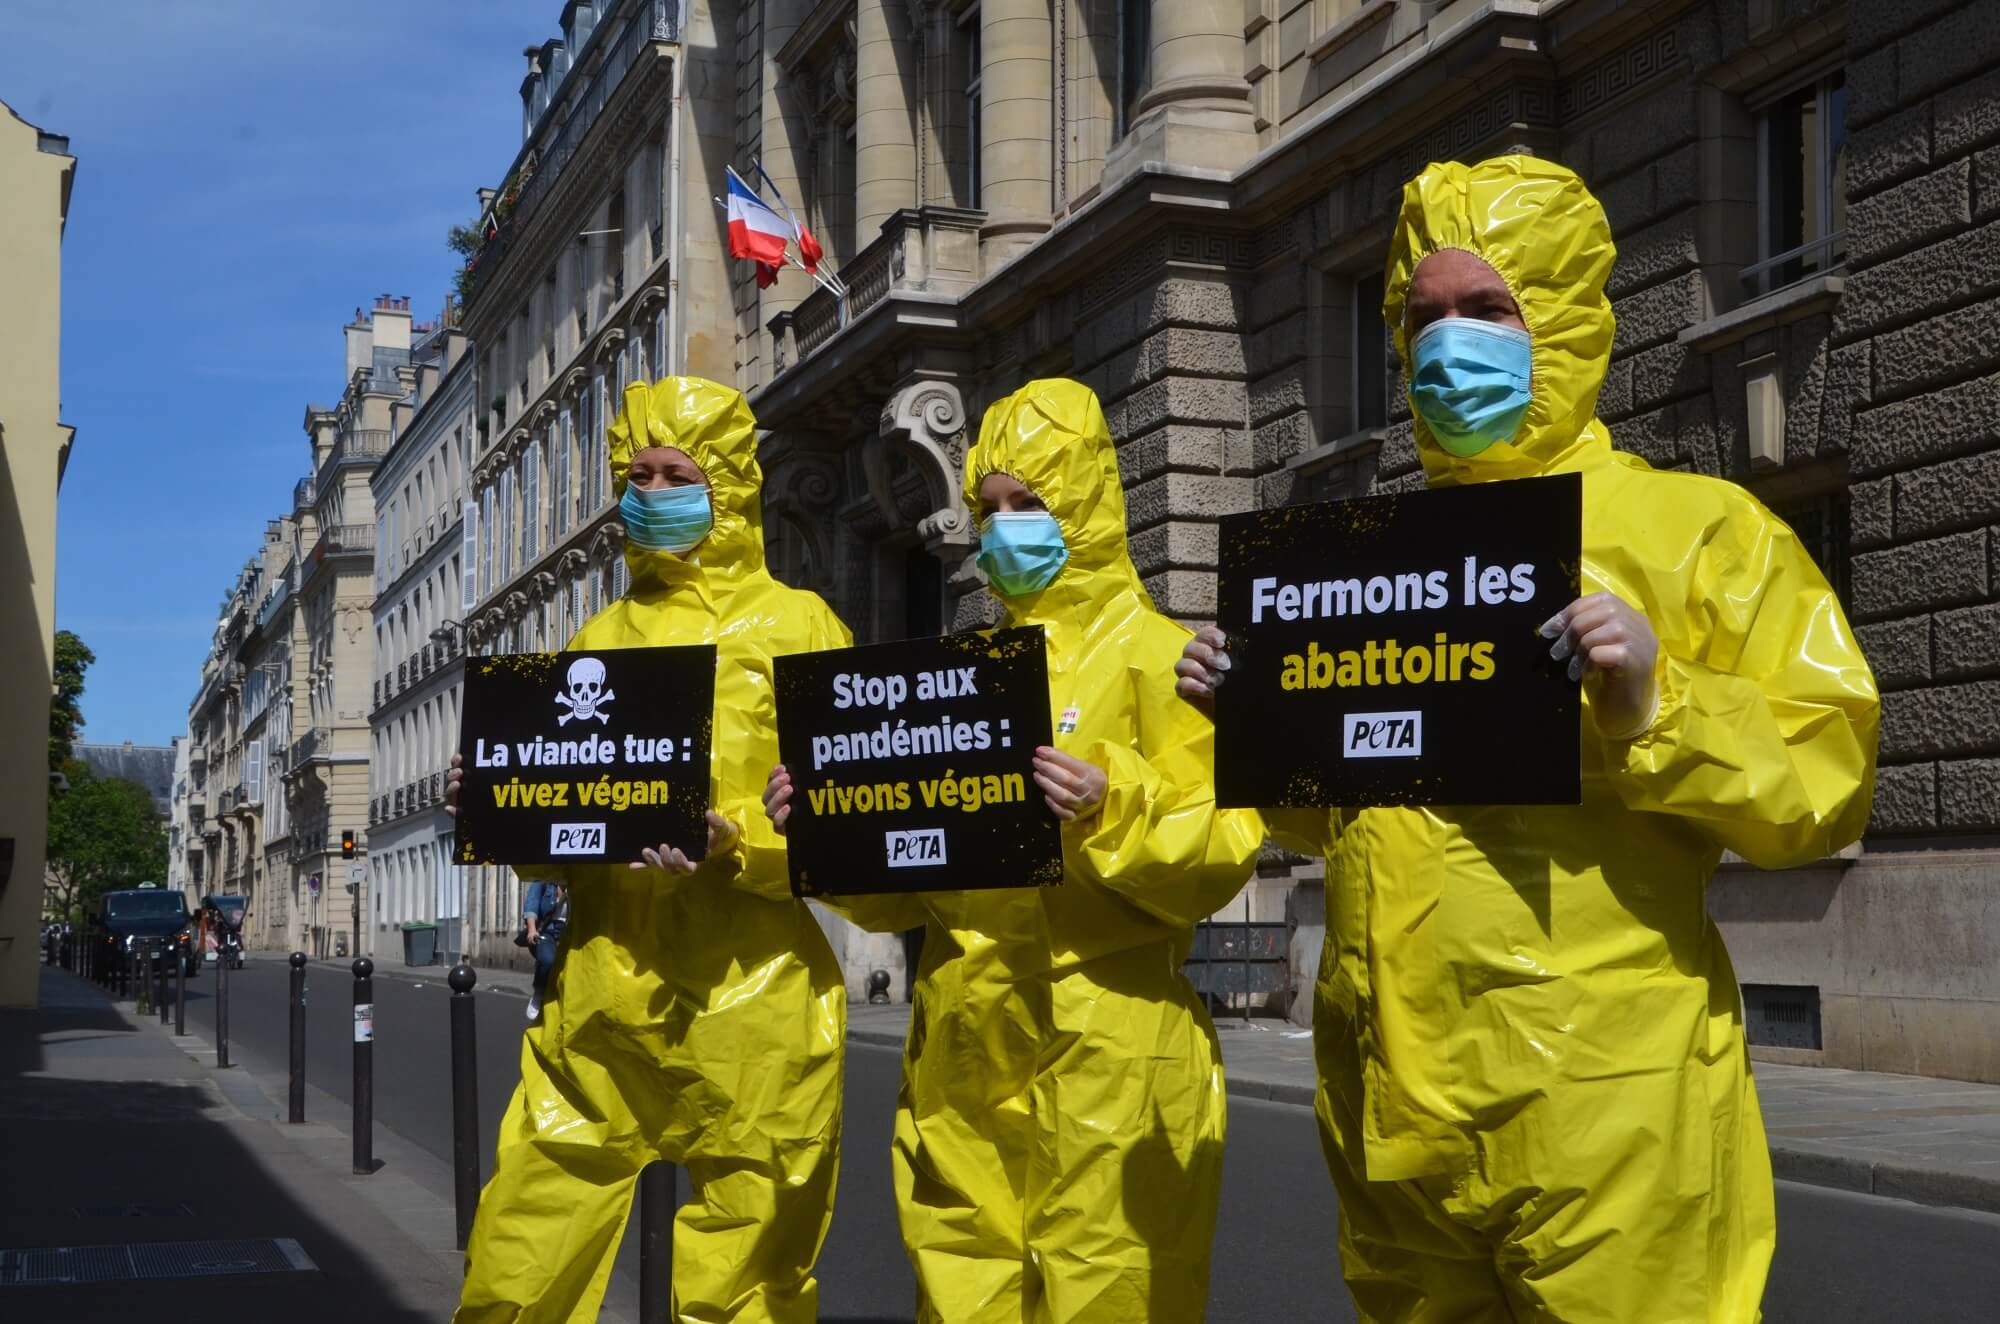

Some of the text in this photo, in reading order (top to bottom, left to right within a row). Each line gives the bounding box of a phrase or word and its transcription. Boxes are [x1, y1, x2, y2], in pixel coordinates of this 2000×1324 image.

[1251, 555, 1536, 624] Fermons les
[1280, 632, 1496, 691] abattoirs
[833, 666, 979, 711] Stop aux
[475, 738, 509, 768] La
[516, 733, 616, 767] viande
[623, 733, 674, 764] tue
[812, 715, 992, 771] pandémies
[492, 774, 669, 812] vivez végan
[807, 768, 1026, 816] vivons végan
